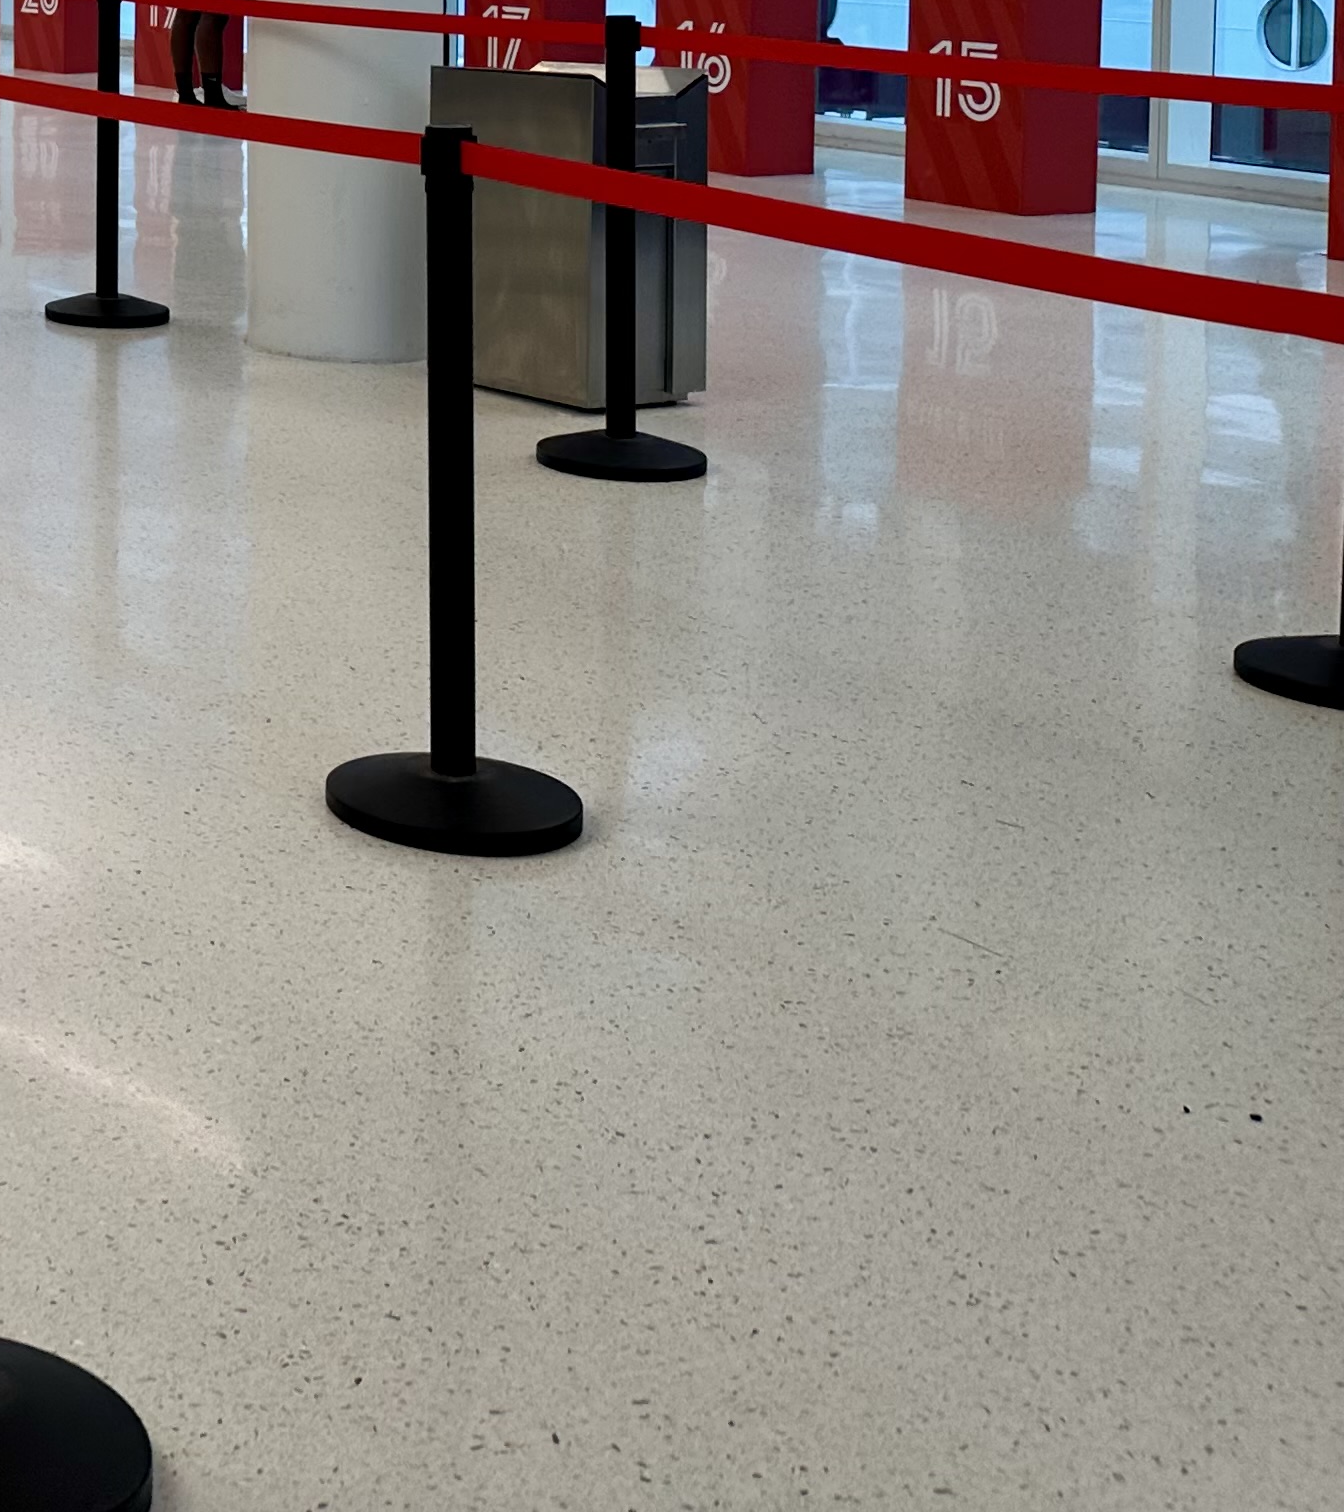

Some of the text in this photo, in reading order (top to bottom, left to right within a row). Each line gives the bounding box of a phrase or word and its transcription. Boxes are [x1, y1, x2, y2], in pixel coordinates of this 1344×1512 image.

[482, 5, 530, 70] 17
[676, 20, 731, 94] 16
[929, 40, 1001, 122] 15
